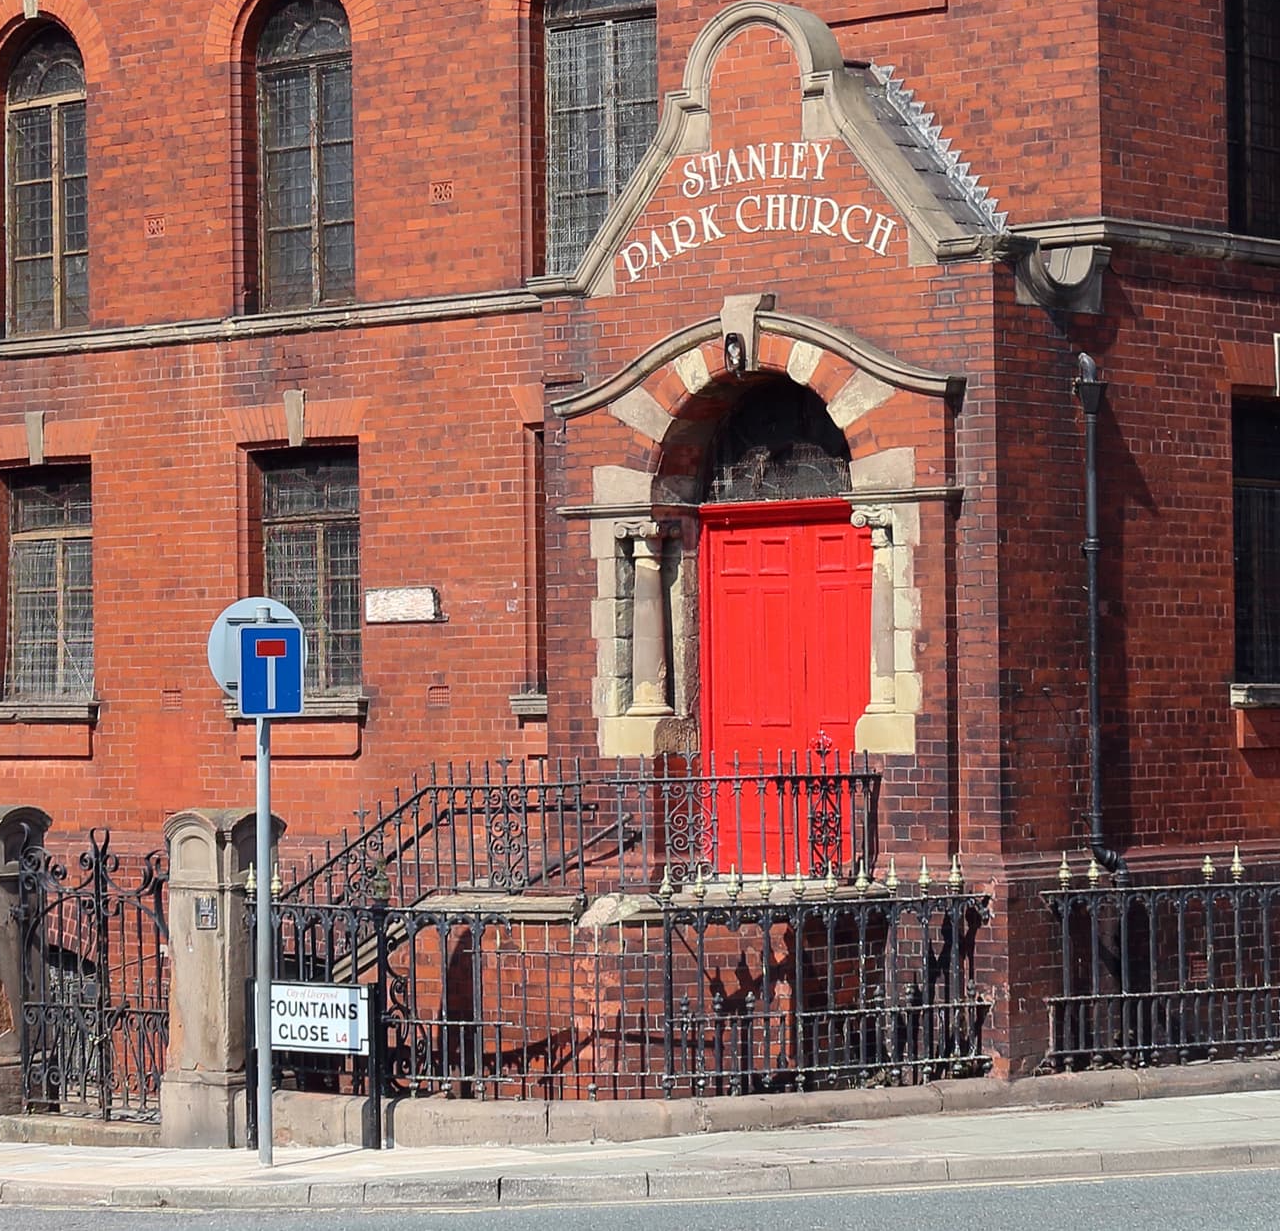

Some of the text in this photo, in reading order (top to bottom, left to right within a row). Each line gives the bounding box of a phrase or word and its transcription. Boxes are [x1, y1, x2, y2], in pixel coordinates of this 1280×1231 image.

[682, 141, 832, 199] STANLEY
[620, 194, 898, 283] PARK CHURCH
[278, 1023, 330, 1043] CLOSE
[335, 1032, 348, 1043] L4
